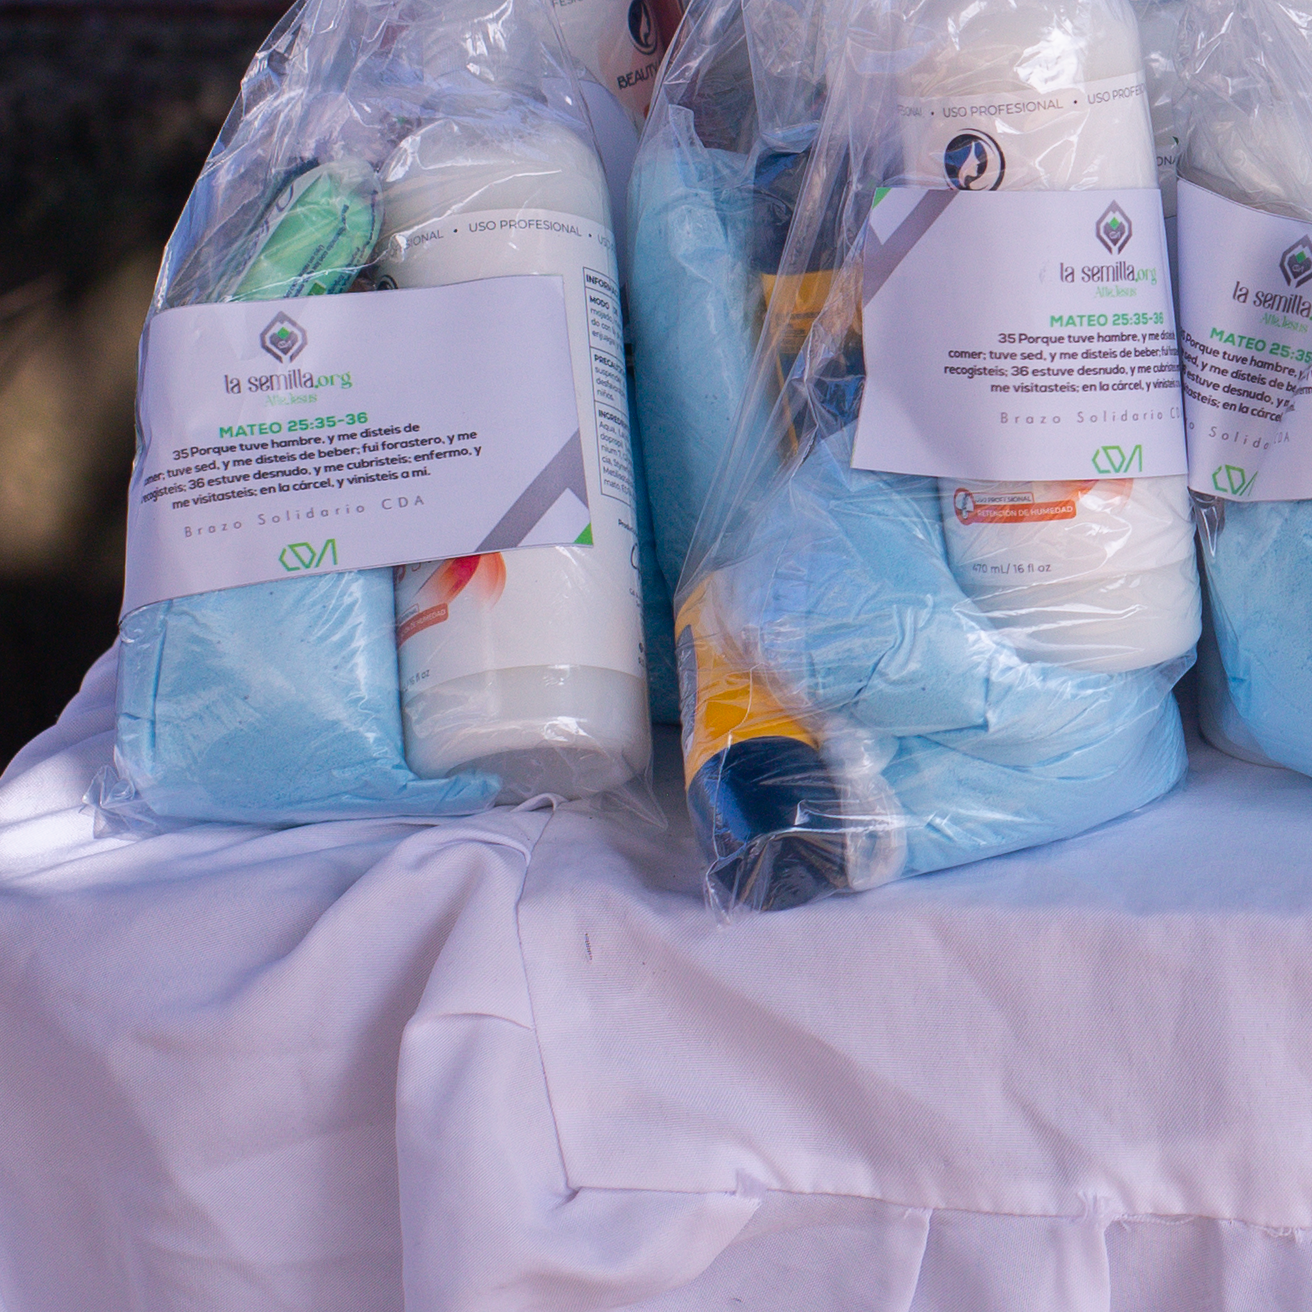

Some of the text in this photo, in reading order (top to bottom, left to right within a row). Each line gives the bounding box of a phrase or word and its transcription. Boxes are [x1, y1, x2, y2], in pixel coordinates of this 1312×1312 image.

[942, 100, 1062, 118] USO PROFESIONAL
[468, 219, 581, 237] USO PROFESIONAL
[1060, 262, 1075, 283] la
[1050, 314, 1108, 327] MATEO
[224, 369, 352, 394] la semilla.org
[219, 412, 368, 438] MATEO 25:35-36
[999, 409, 1163, 425] Brazo Solidario
[183, 495, 424, 538] Brazo Solidario CDA
